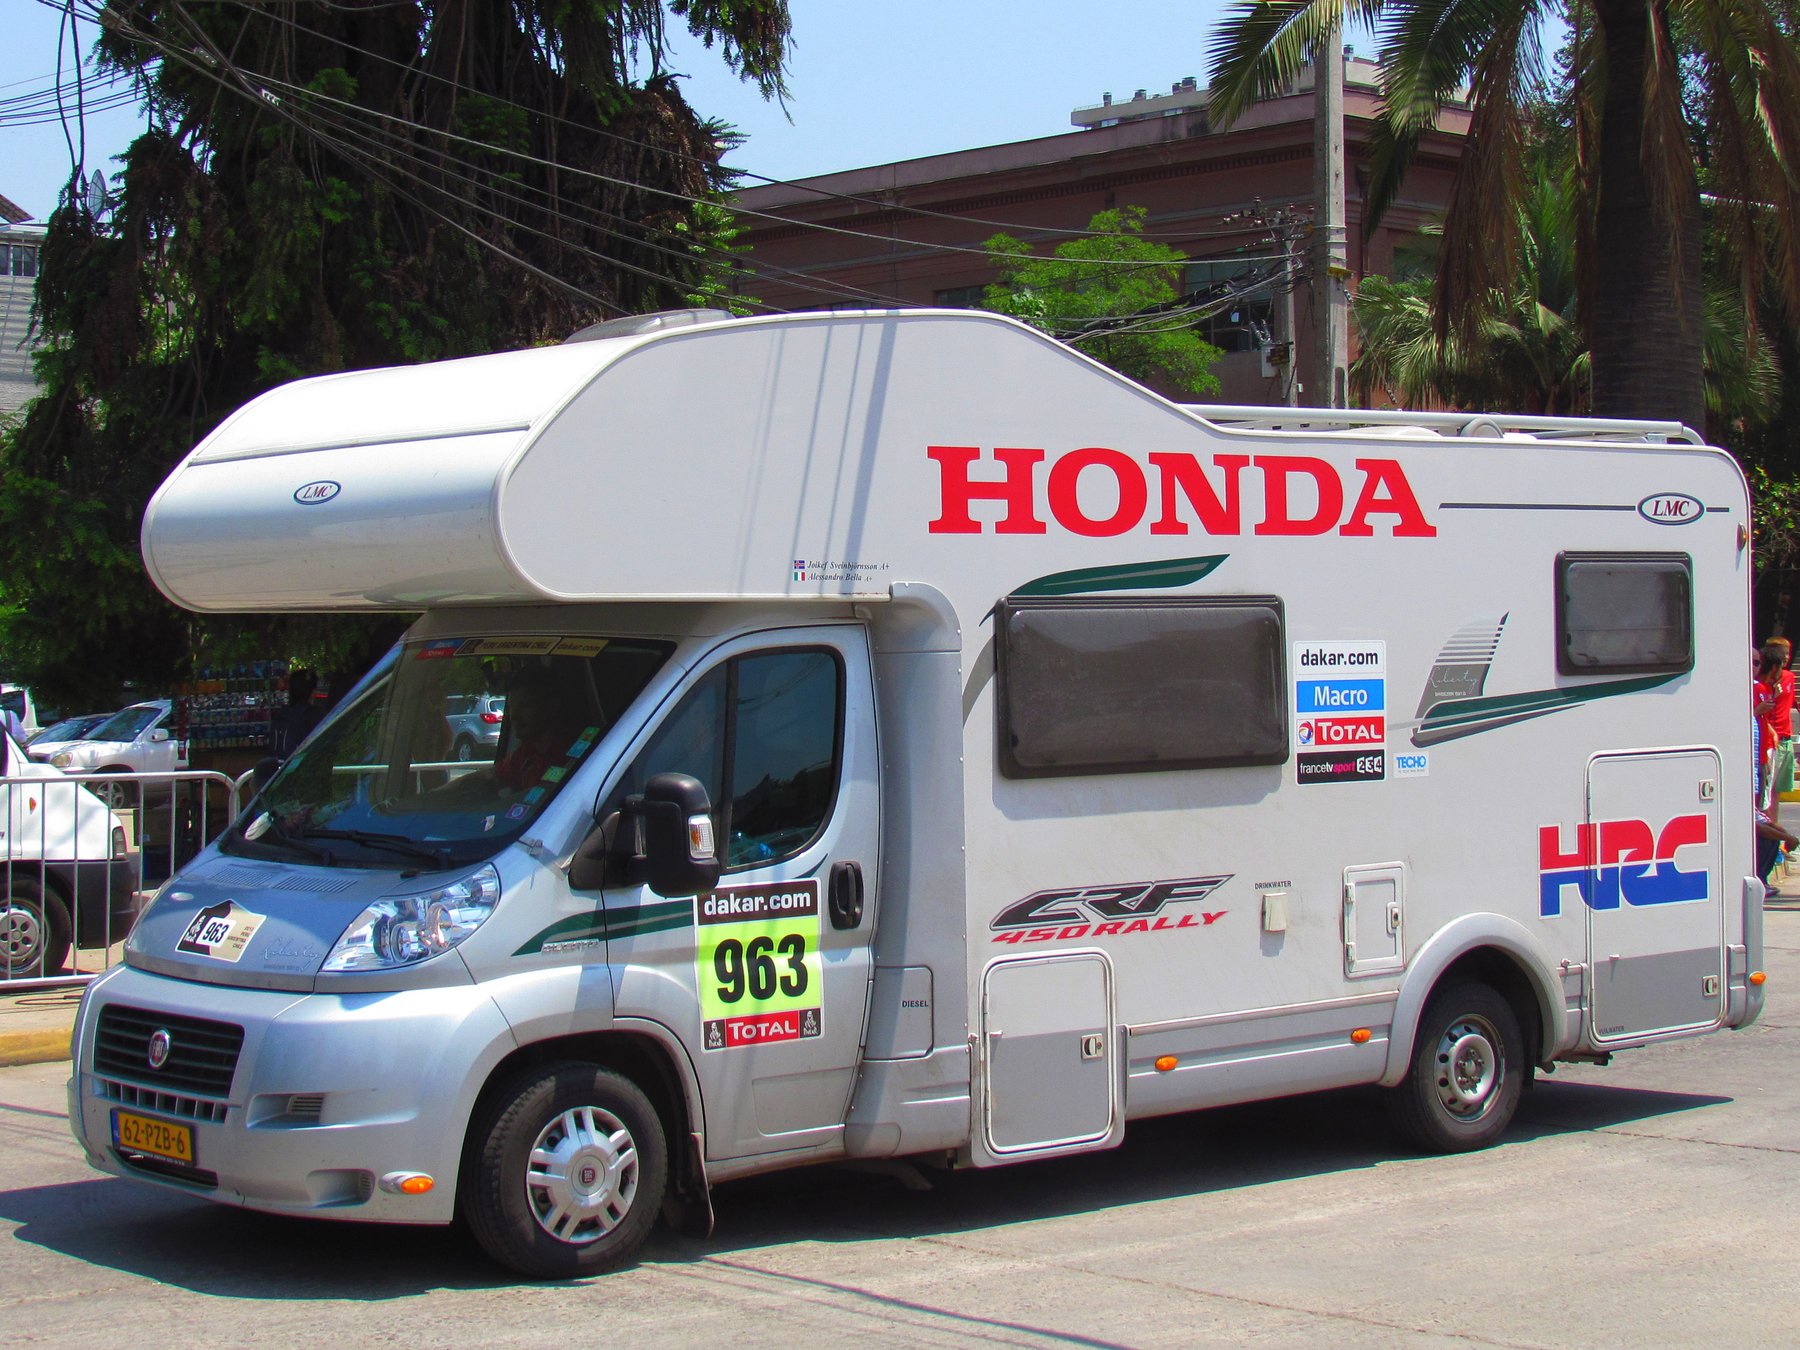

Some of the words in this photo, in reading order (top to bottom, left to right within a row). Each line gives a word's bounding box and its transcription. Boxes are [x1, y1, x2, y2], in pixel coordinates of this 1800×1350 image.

[302, 485, 333, 499] LMC
[927, 446, 1437, 537] HONDA
[1652, 500, 1690, 517] LMC
[807, 572, 843, 581] Alessandro
[1300, 648, 1379, 667] dakar.com
[1314, 685, 1368, 706] Macro
[1317, 721, 1382, 741] TOTAL
[1396, 755, 1427, 769] TECHO
[1538, 813, 1709, 918] HRC
[1254, 880, 1292, 889] DRINKWATER
[704, 891, 811, 916] dakar.com
[989, 873, 1236, 932] CRF
[202, 921, 230, 944] 963
[713, 933, 809, 1004] 963
[901, 1000, 929, 1008] DIESEL
[728, 1020, 797, 1040] TOTAL
[123, 1118, 185, 1155] 62-PZB-6
